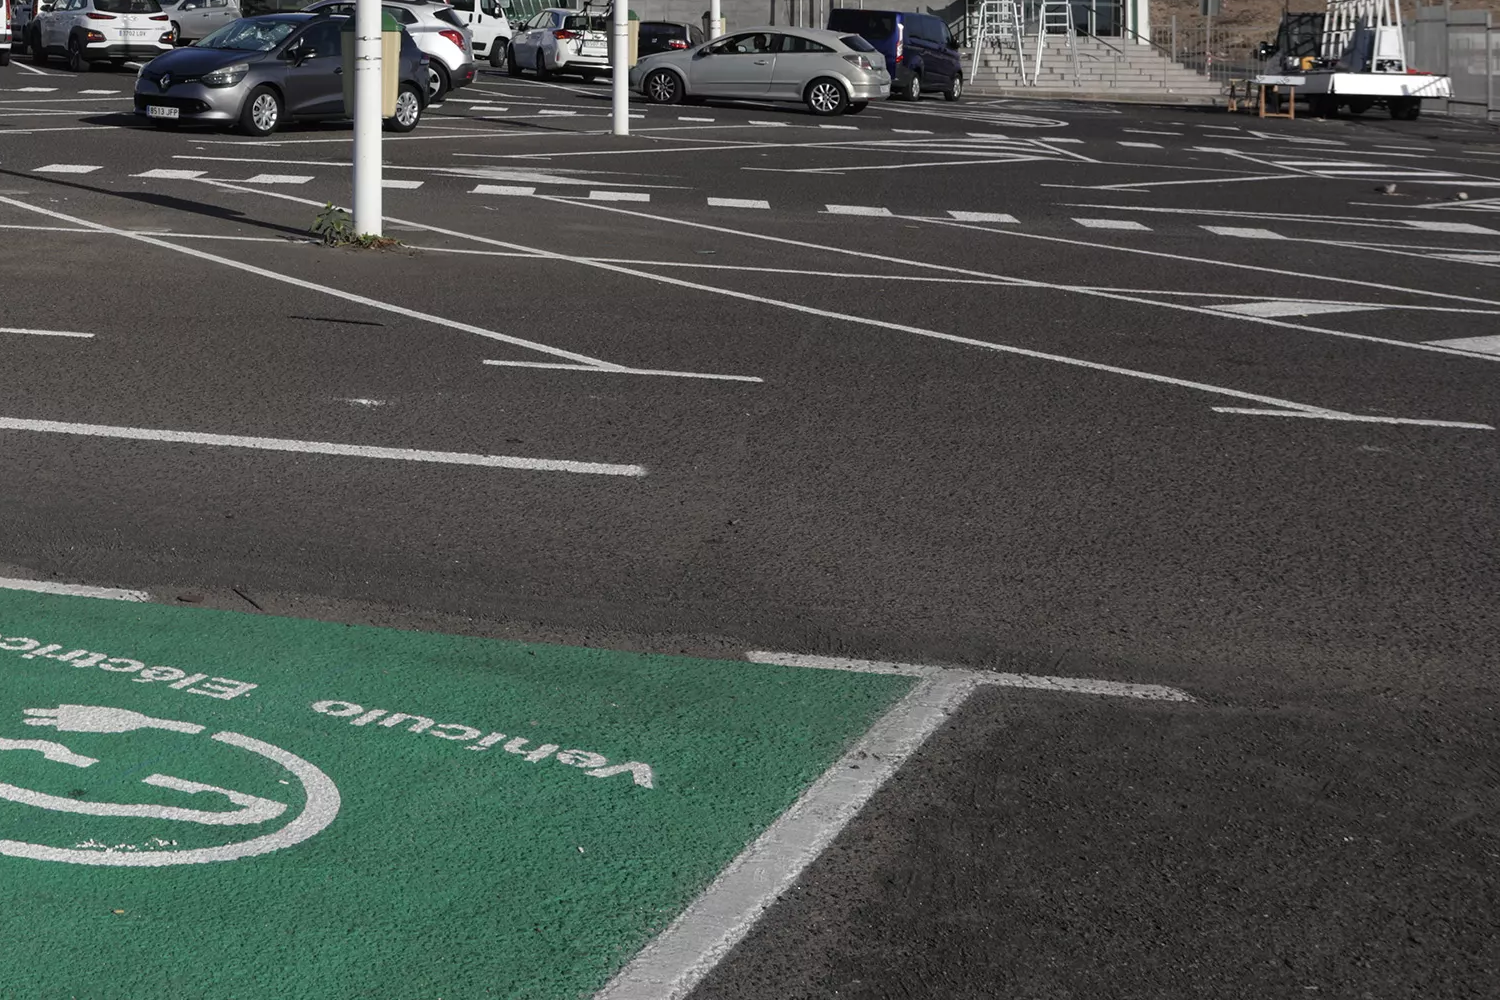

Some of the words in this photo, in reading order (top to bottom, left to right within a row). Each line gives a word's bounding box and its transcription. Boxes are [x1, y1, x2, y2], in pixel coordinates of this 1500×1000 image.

[150, 106, 165, 115] 8513
[166, 108, 178, 116] JFP
[311, 699, 654, 789] Vehículo
